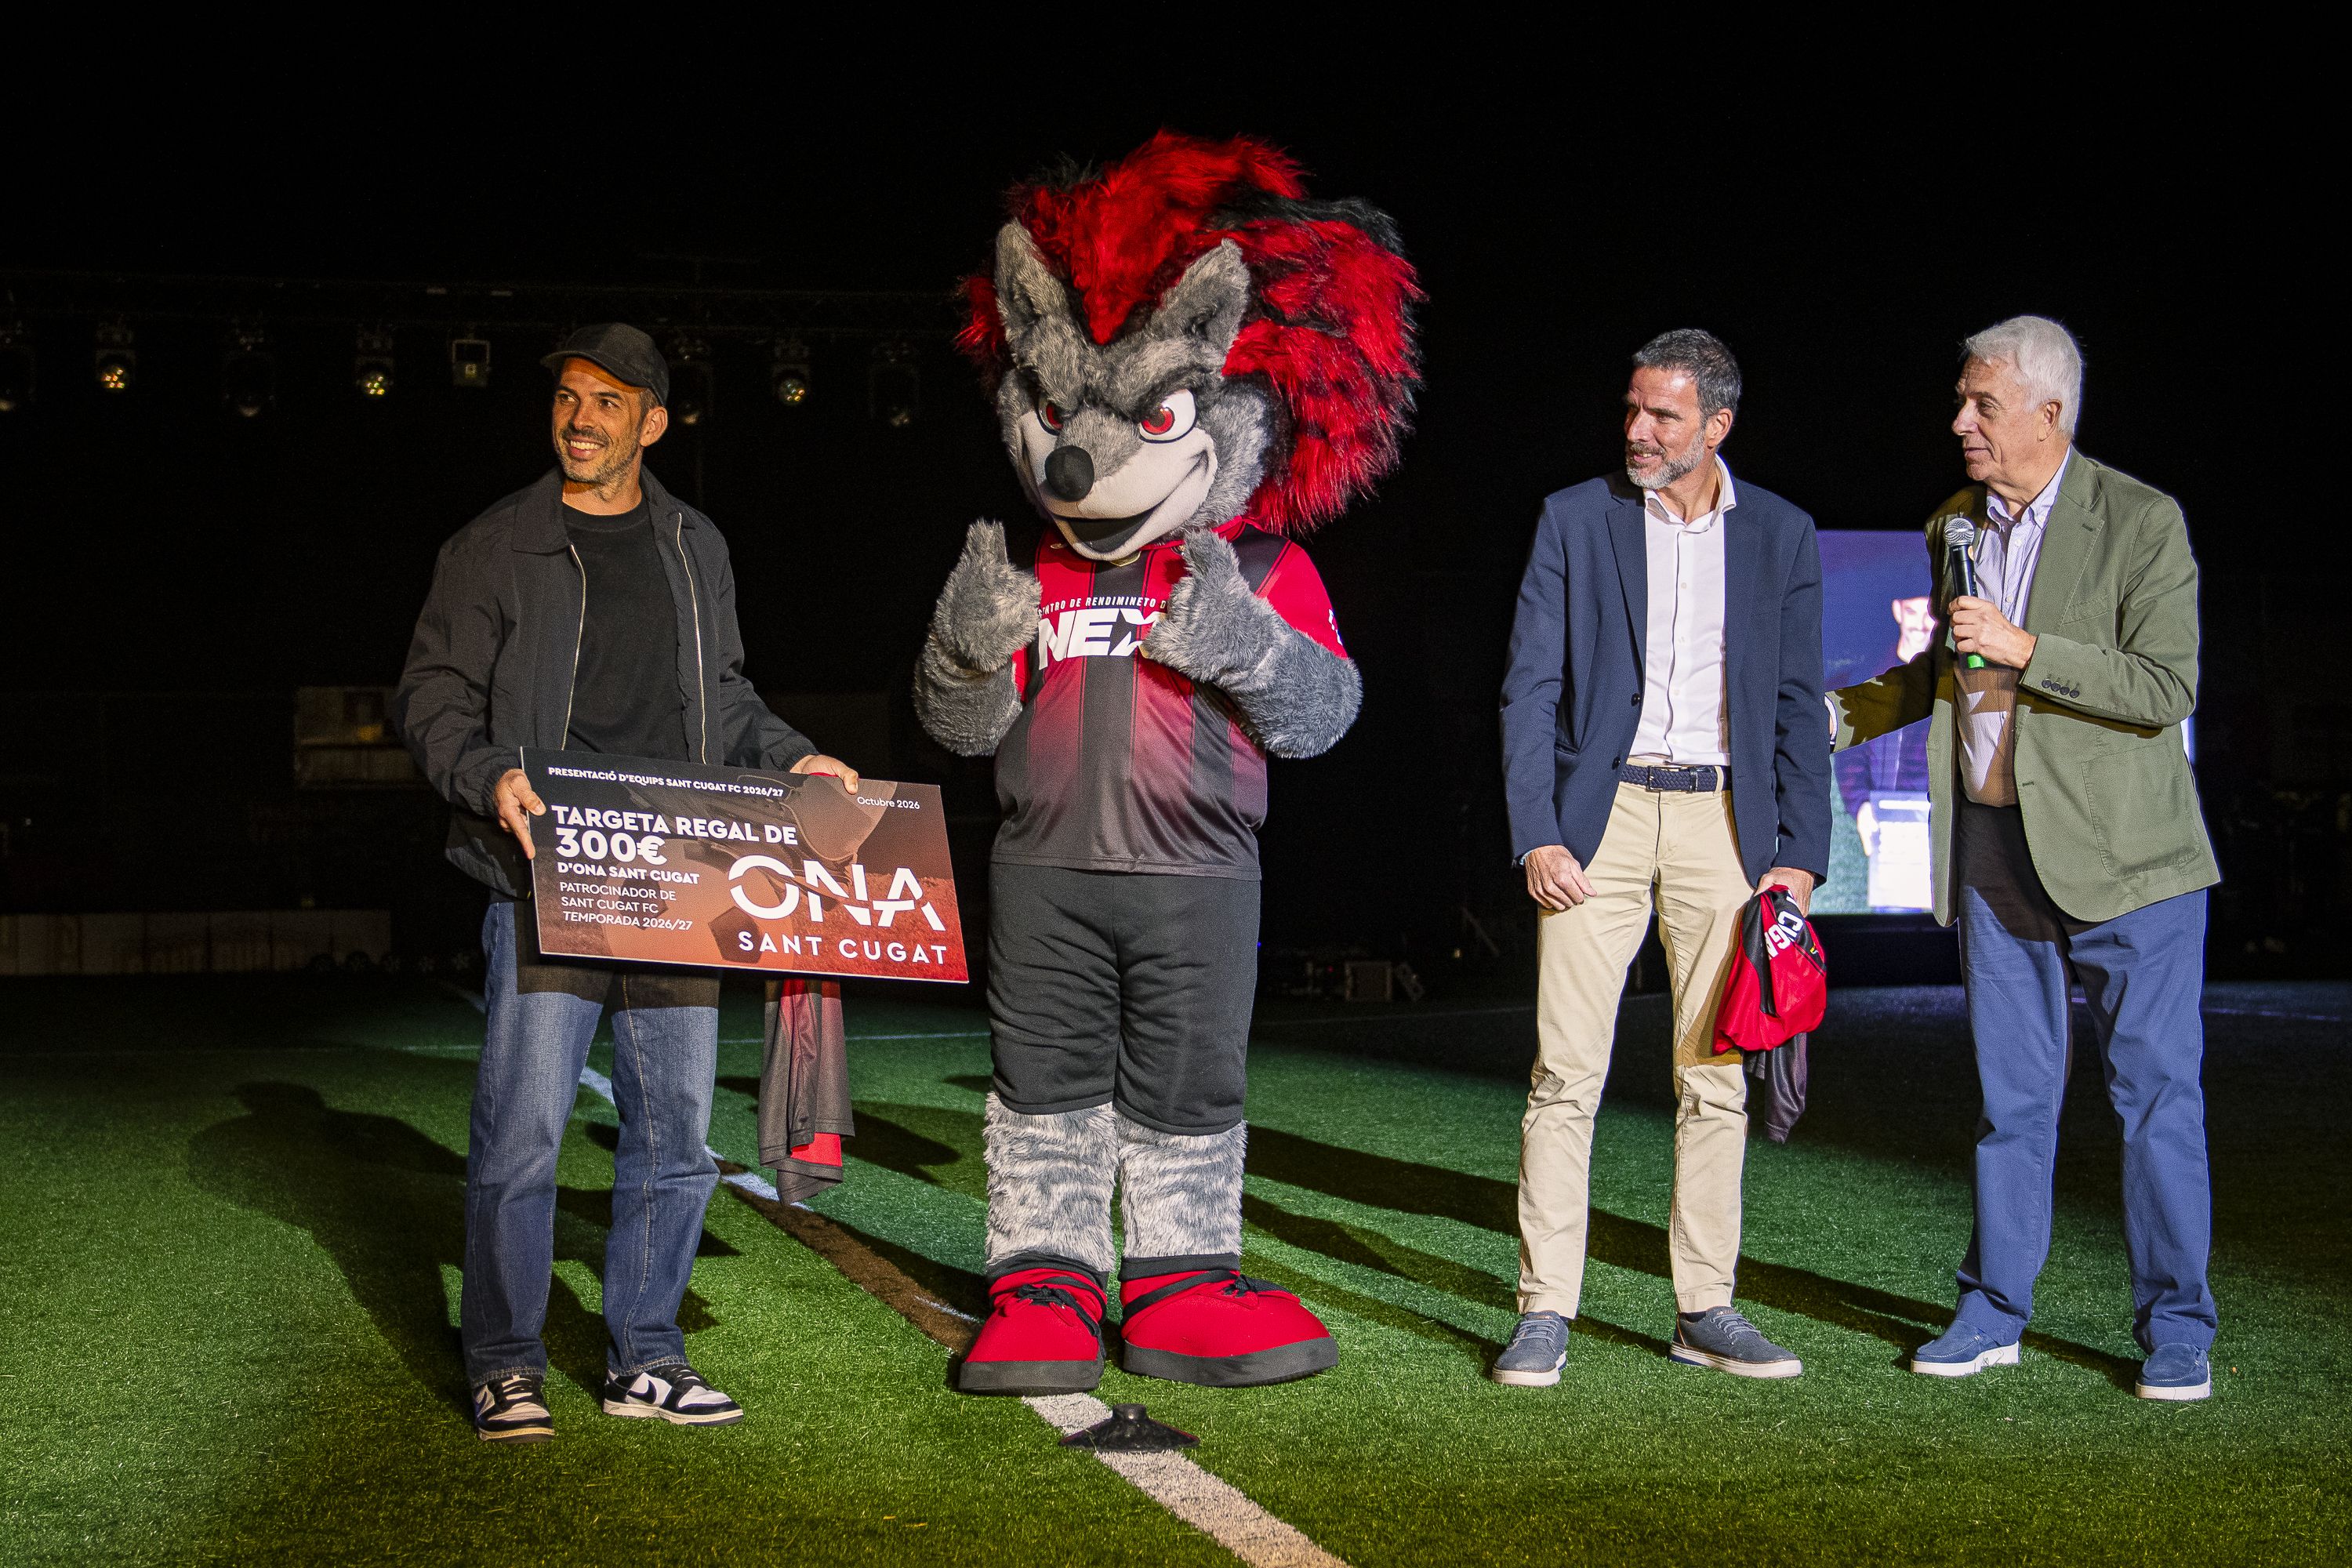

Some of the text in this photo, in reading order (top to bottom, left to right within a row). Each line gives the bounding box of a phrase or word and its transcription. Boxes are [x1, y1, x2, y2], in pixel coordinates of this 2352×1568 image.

[1069, 597, 1082, 608] DE
[1085, 596, 1156, 608] RENDIMINETO
[548, 767, 784, 797] PRESENTACIÓ D'EQUIPS SANT CUGAT FC 2026/27
[857, 796, 920, 810] Octubre 2026
[551, 804, 798, 845] TARGETA REGAL DE
[555, 827, 667, 865] 300€
[557, 862, 700, 884] D'ONA SANT CUGAT
[559, 881, 677, 901] PATROCINADOR DE
[728, 854, 946, 931] ONA
[561, 896, 659, 914] SANT CUGAT FC
[562, 910, 693, 931] TEMPORADA 2026/27
[738, 931, 948, 965] SANT CUGAT
